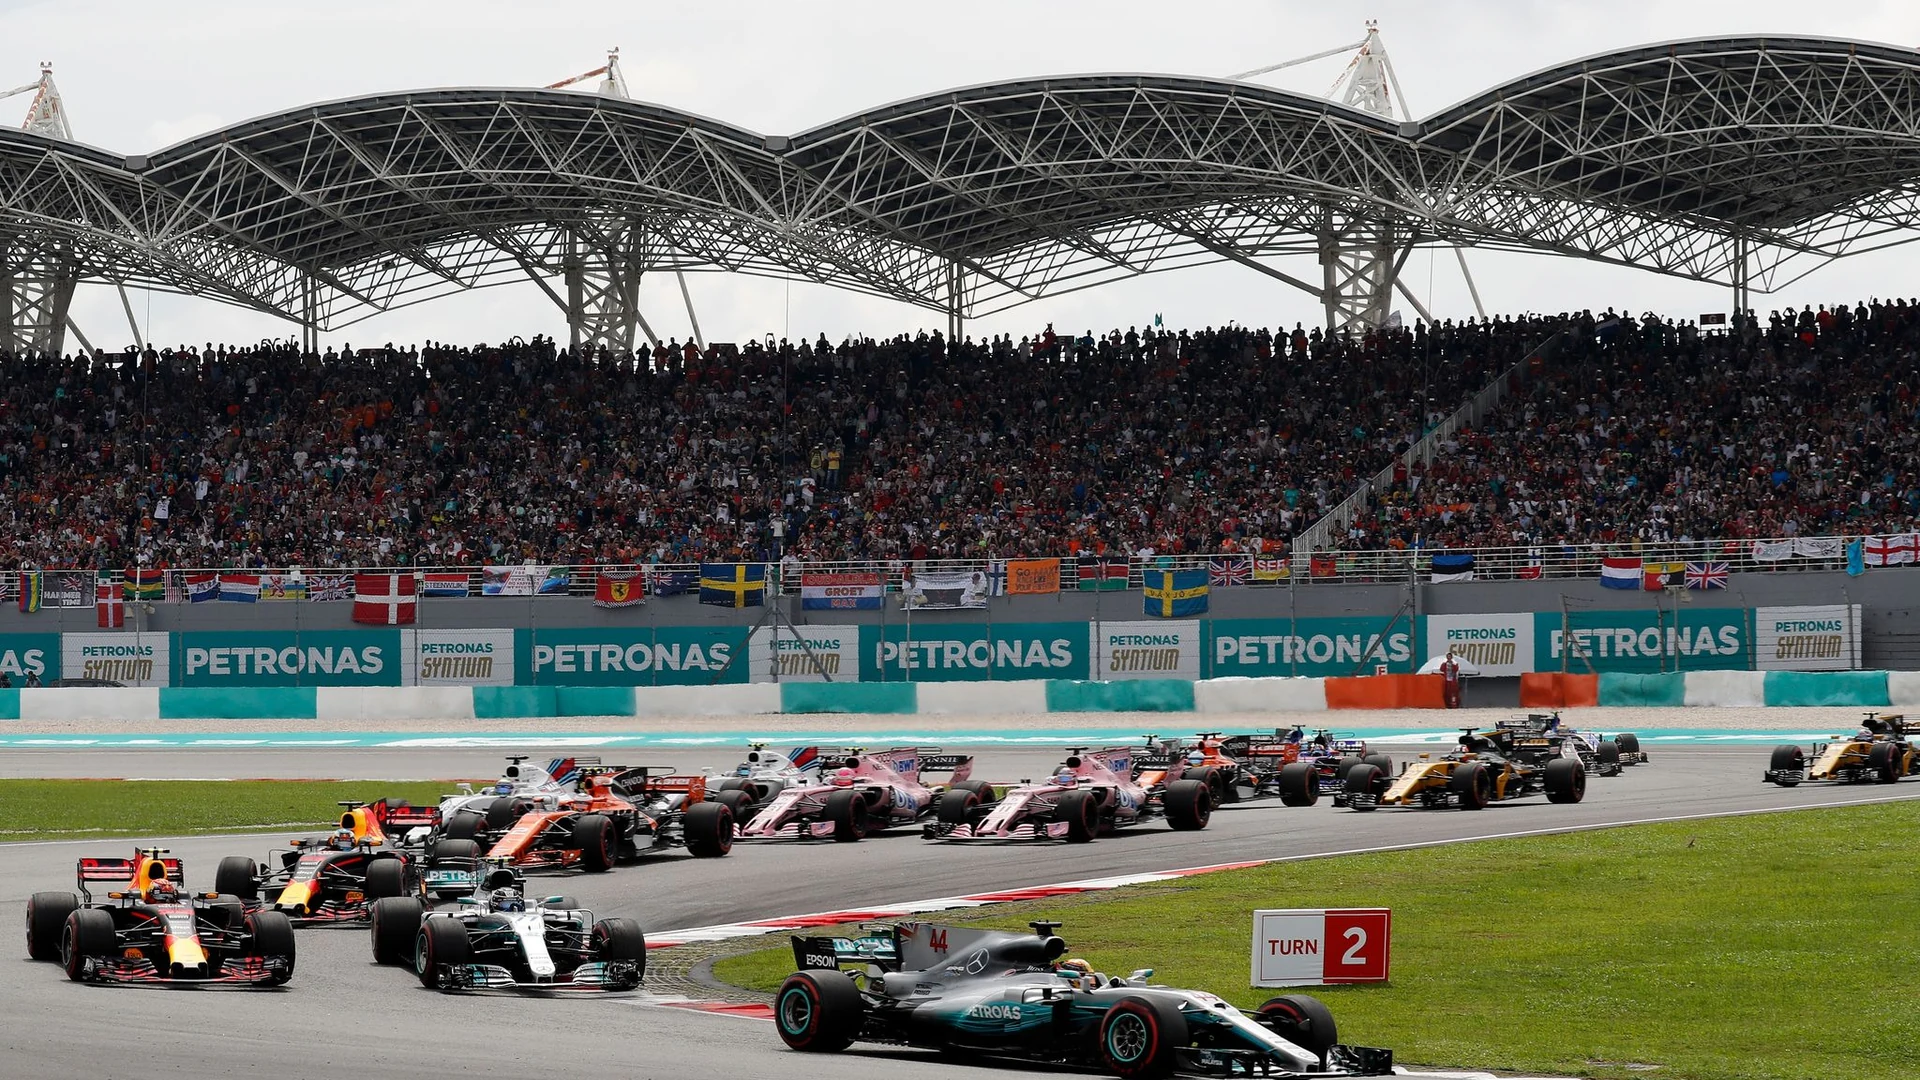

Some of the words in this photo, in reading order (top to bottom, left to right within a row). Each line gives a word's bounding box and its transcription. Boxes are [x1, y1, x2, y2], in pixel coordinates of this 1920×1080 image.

[1016, 568, 1030, 576] GO
[825, 587, 864, 597] GROET
[831, 598, 857, 608] MAX
[1447, 628, 1516, 640] PETRONAS
[1776, 620, 1842, 632] PETRONAS
[82, 645, 153, 656] PETRONAS
[421, 643, 493, 654] PETRONAS
[1110, 635, 1179, 646] PETRONAS
[1217, 633, 1411, 664] PETRONAS
[1551, 625, 1739, 658] PETRONAS
[1776, 635, 1841, 659] SYNTIUM
[187, 646, 384, 675] PETRONAS
[535, 643, 731, 673] PETRONAS
[877, 639, 1073, 669] PETRONAS
[1110, 648, 1180, 672] SYNTIUM
[82, 659, 153, 681] SYNTIUM
[421, 656, 493, 679] SYNTIUM
[929, 928, 948, 954] 44
[1268, 939, 1317, 956] TURN
[1341, 926, 1367, 965] 2
[806, 954, 835, 968] EPSON
